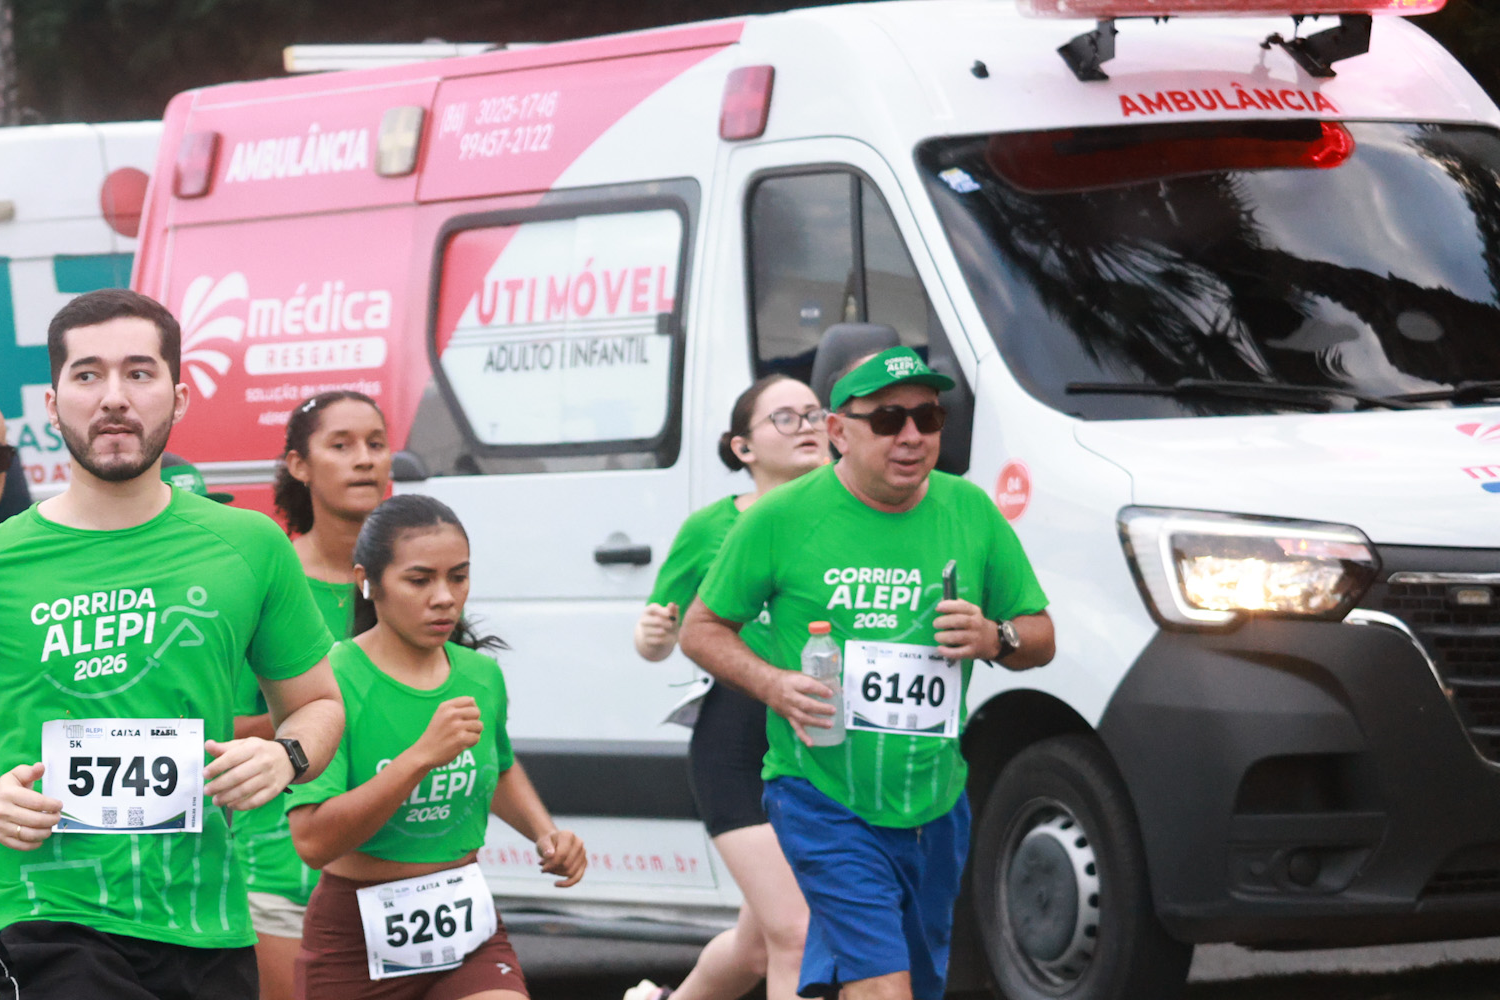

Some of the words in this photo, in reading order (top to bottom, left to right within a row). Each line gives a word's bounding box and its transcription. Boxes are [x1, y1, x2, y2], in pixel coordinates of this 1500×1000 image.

[1118, 81, 1339, 117] AMBULÂNCIA
[225, 121, 369, 183] AMBULÂNCIA
[246, 279, 392, 338] médica
[476, 278, 537, 326] UTI
[545, 257, 675, 320] MÓVEL
[266, 343, 363, 367] RESGATE
[483, 343, 553, 373] ADULTO
[569, 337, 650, 368] INFANTIL
[824, 567, 922, 585] CORRIDA
[30, 587, 156, 626] CORRIDA
[827, 584, 922, 611] ALEPI
[41, 611, 157, 663] ALEPI
[853, 613, 898, 629] 2026
[73, 653, 127, 681] 2026
[861, 671, 946, 708] 6140
[69, 740, 82, 748] 5K
[110, 729, 141, 737] CAIXA
[150, 729, 178, 737] BRASIL
[67, 756, 179, 797] 5749
[401, 770, 478, 807] LEPI
[405, 805, 451, 823] 2026
[385, 898, 474, 948] 5267
